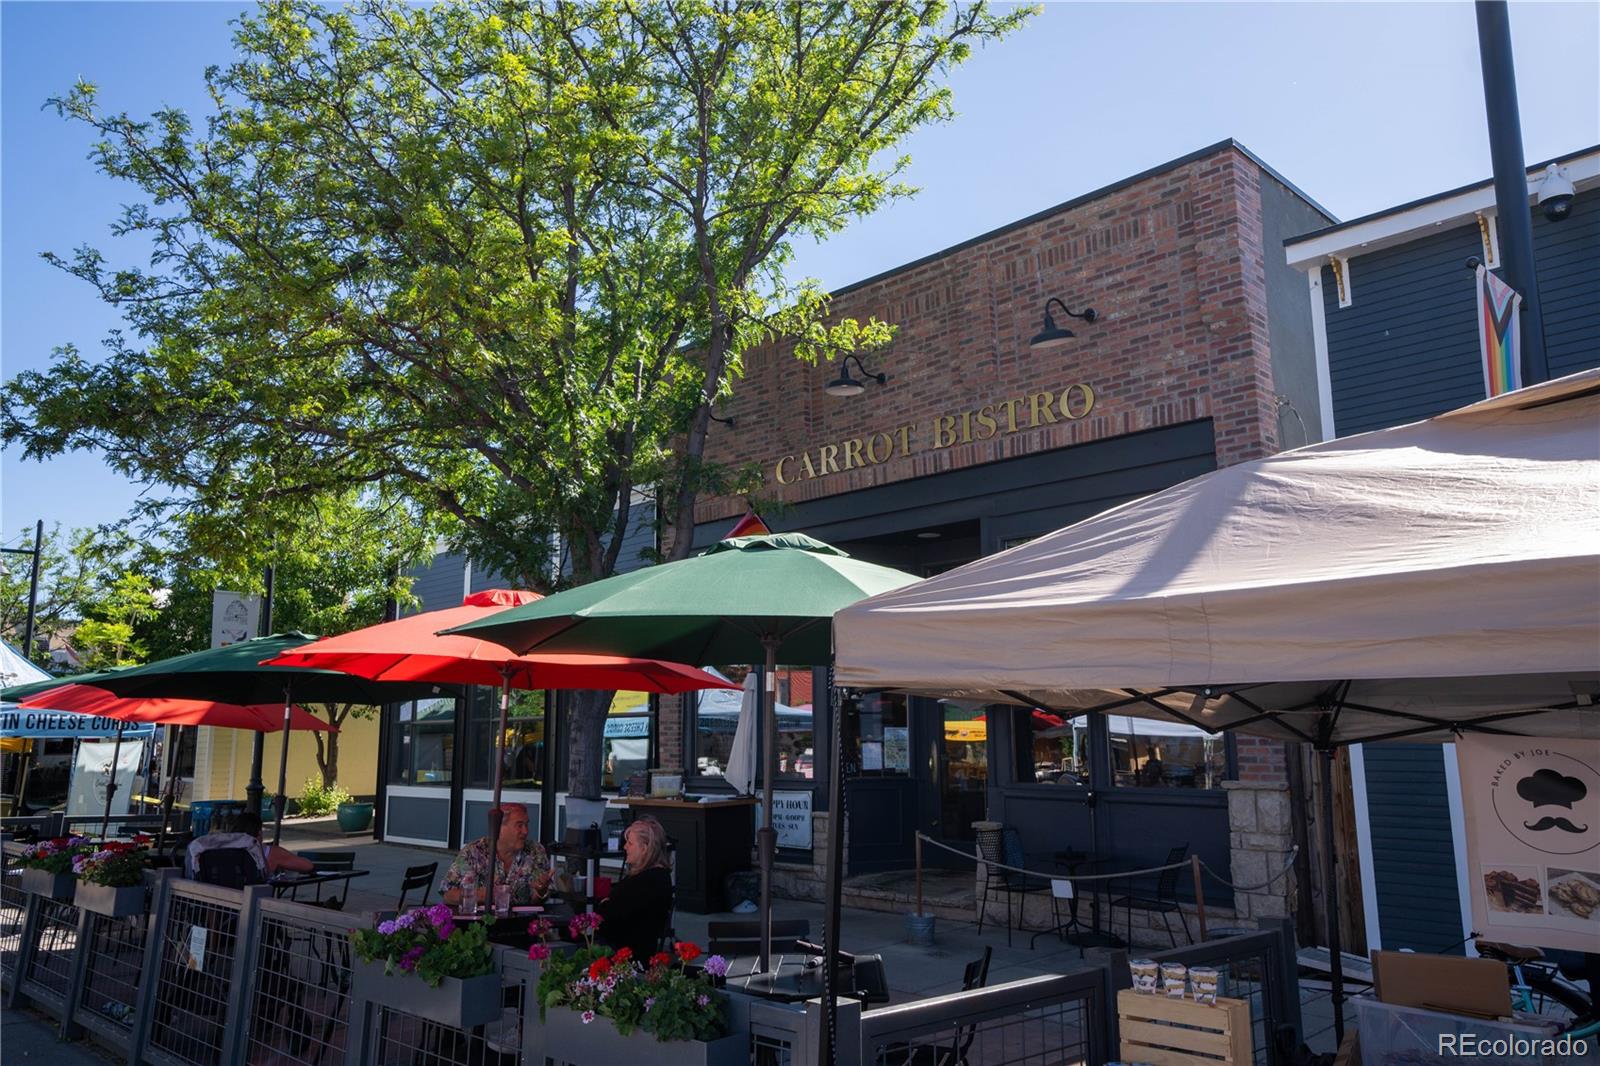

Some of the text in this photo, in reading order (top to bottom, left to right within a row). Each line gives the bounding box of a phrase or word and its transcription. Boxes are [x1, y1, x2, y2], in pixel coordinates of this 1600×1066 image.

[775, 383, 1096, 486] CARROT BISTRO
[0, 713, 20, 729] IN
[25, 714, 87, 730] CHEESE
[1491, 759, 1512, 787] BAKED
[1513, 751, 1525, 760] BY
